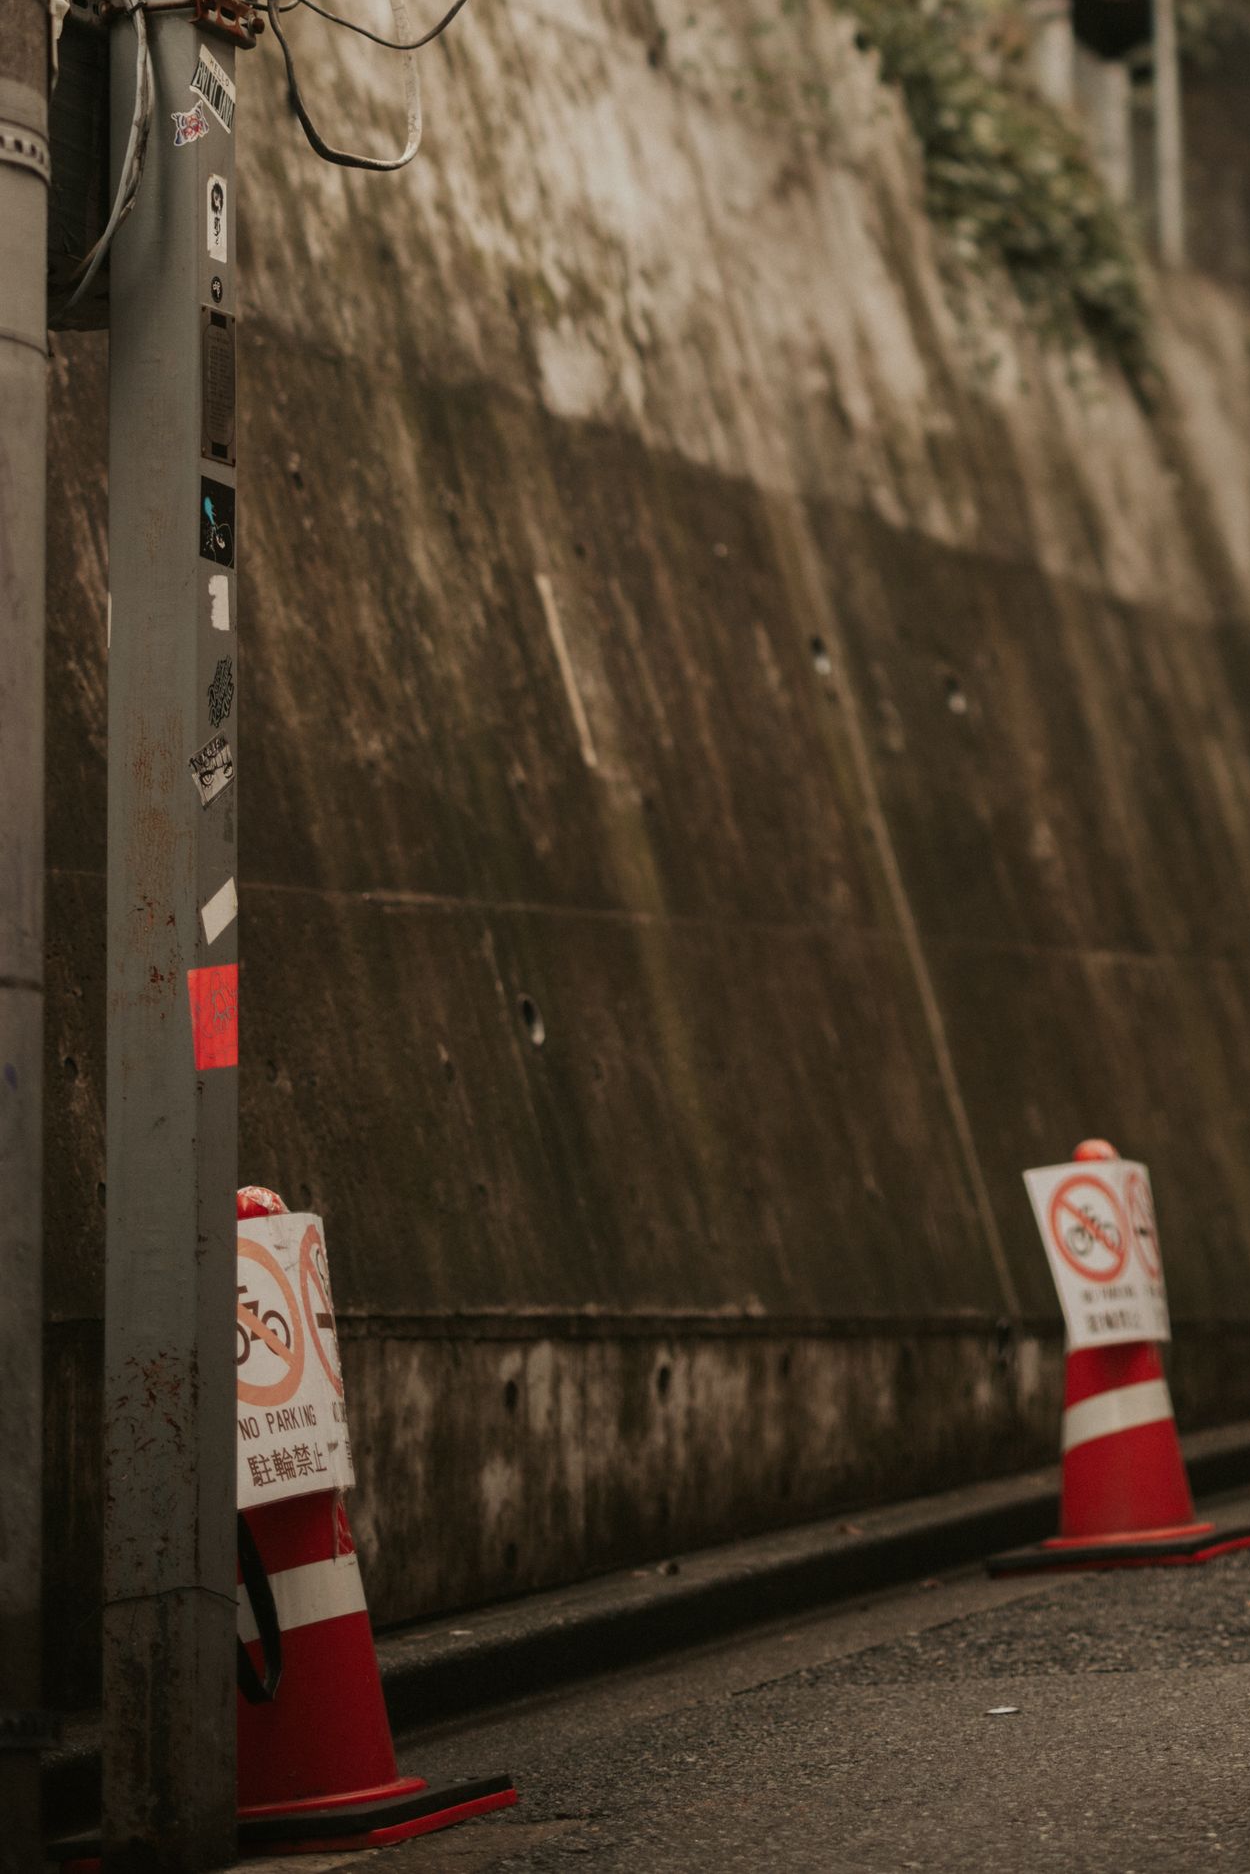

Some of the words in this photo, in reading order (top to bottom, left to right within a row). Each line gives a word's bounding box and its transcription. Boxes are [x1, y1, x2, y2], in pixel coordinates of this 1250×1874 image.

[209, 57, 230, 87] HELLO
[237, 1416, 261, 1441] NO
[265, 1404, 317, 1435] PARKING
[247, 1442, 328, 1487] 駐輪禁止
